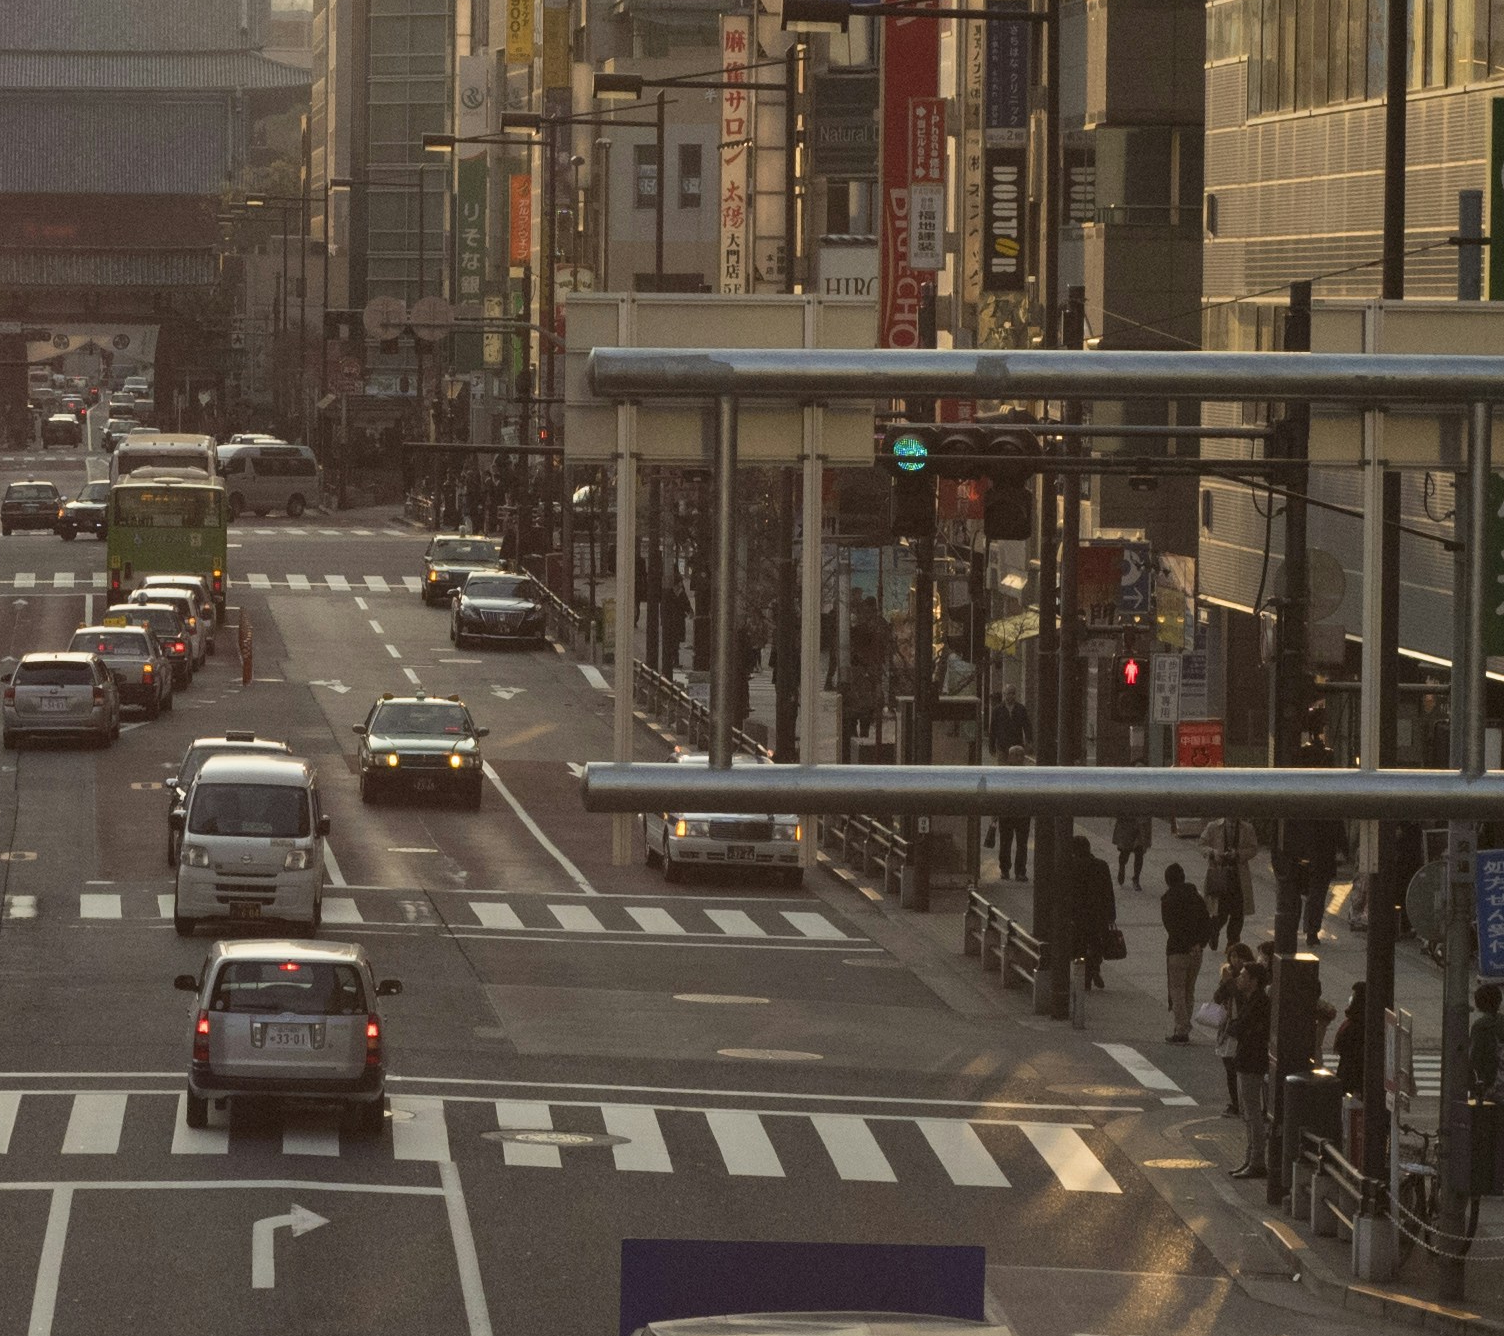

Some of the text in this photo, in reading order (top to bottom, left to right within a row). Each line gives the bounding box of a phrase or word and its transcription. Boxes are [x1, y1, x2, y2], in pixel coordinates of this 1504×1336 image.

[723, 29, 746, 166] 麻雀サロン
[819, 124, 868, 142] Natural
[459, 202, 481, 306] りそな銀
[275, 1033, 306, 1045] 33-01
